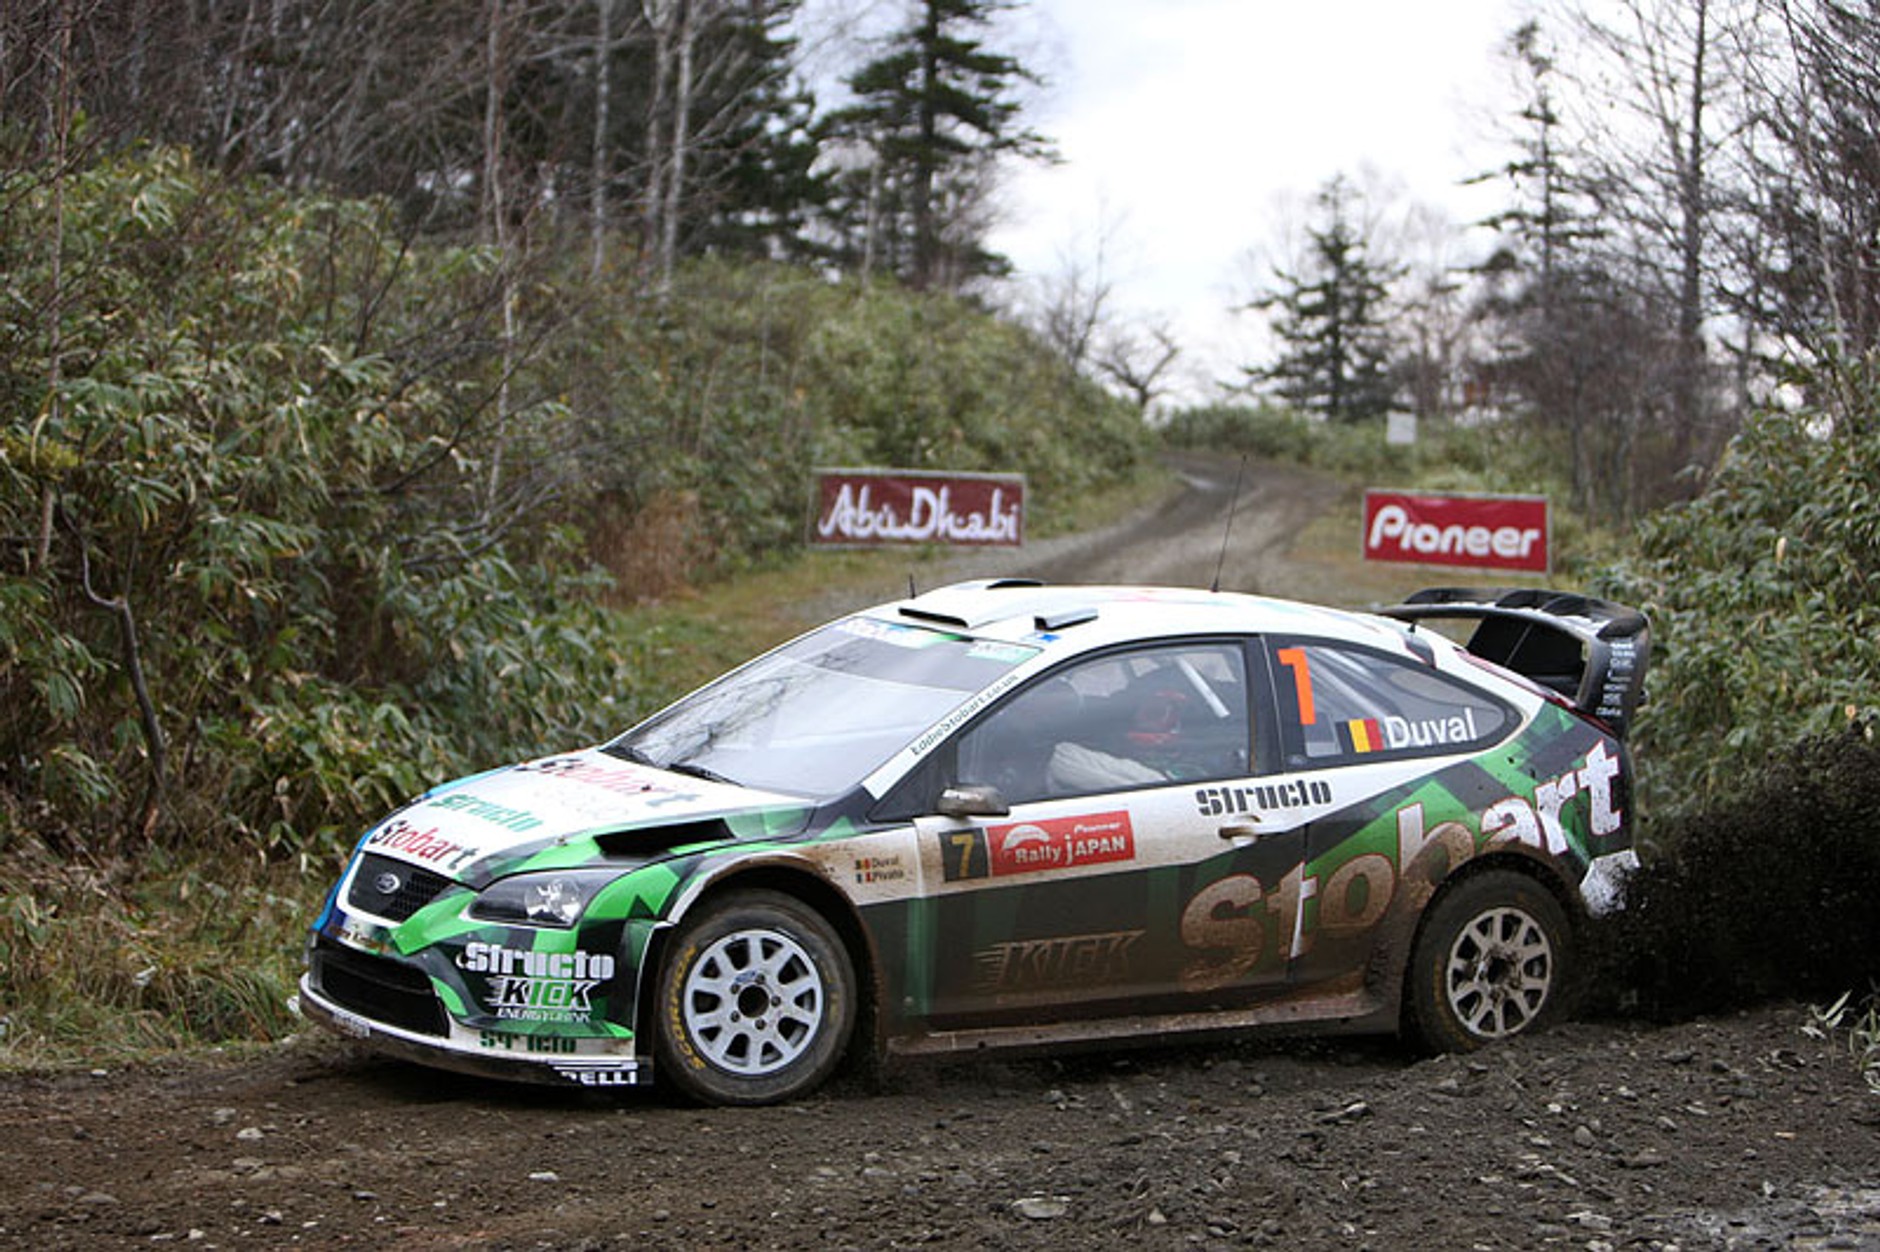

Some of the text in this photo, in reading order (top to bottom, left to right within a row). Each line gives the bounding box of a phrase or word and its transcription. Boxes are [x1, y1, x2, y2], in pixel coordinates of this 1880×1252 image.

[1369, 505, 1540, 558] Pioneer
[1278, 648, 1316, 725] 1
[1384, 707, 1478, 749] Duval
[1195, 779, 1332, 817] Structo
[369, 819, 479, 871] Stobart
[951, 834, 975, 877] 7
[1014, 845, 1062, 864] Rally
[1178, 737, 1624, 988] Stobart
[465, 942, 615, 980] Structo
